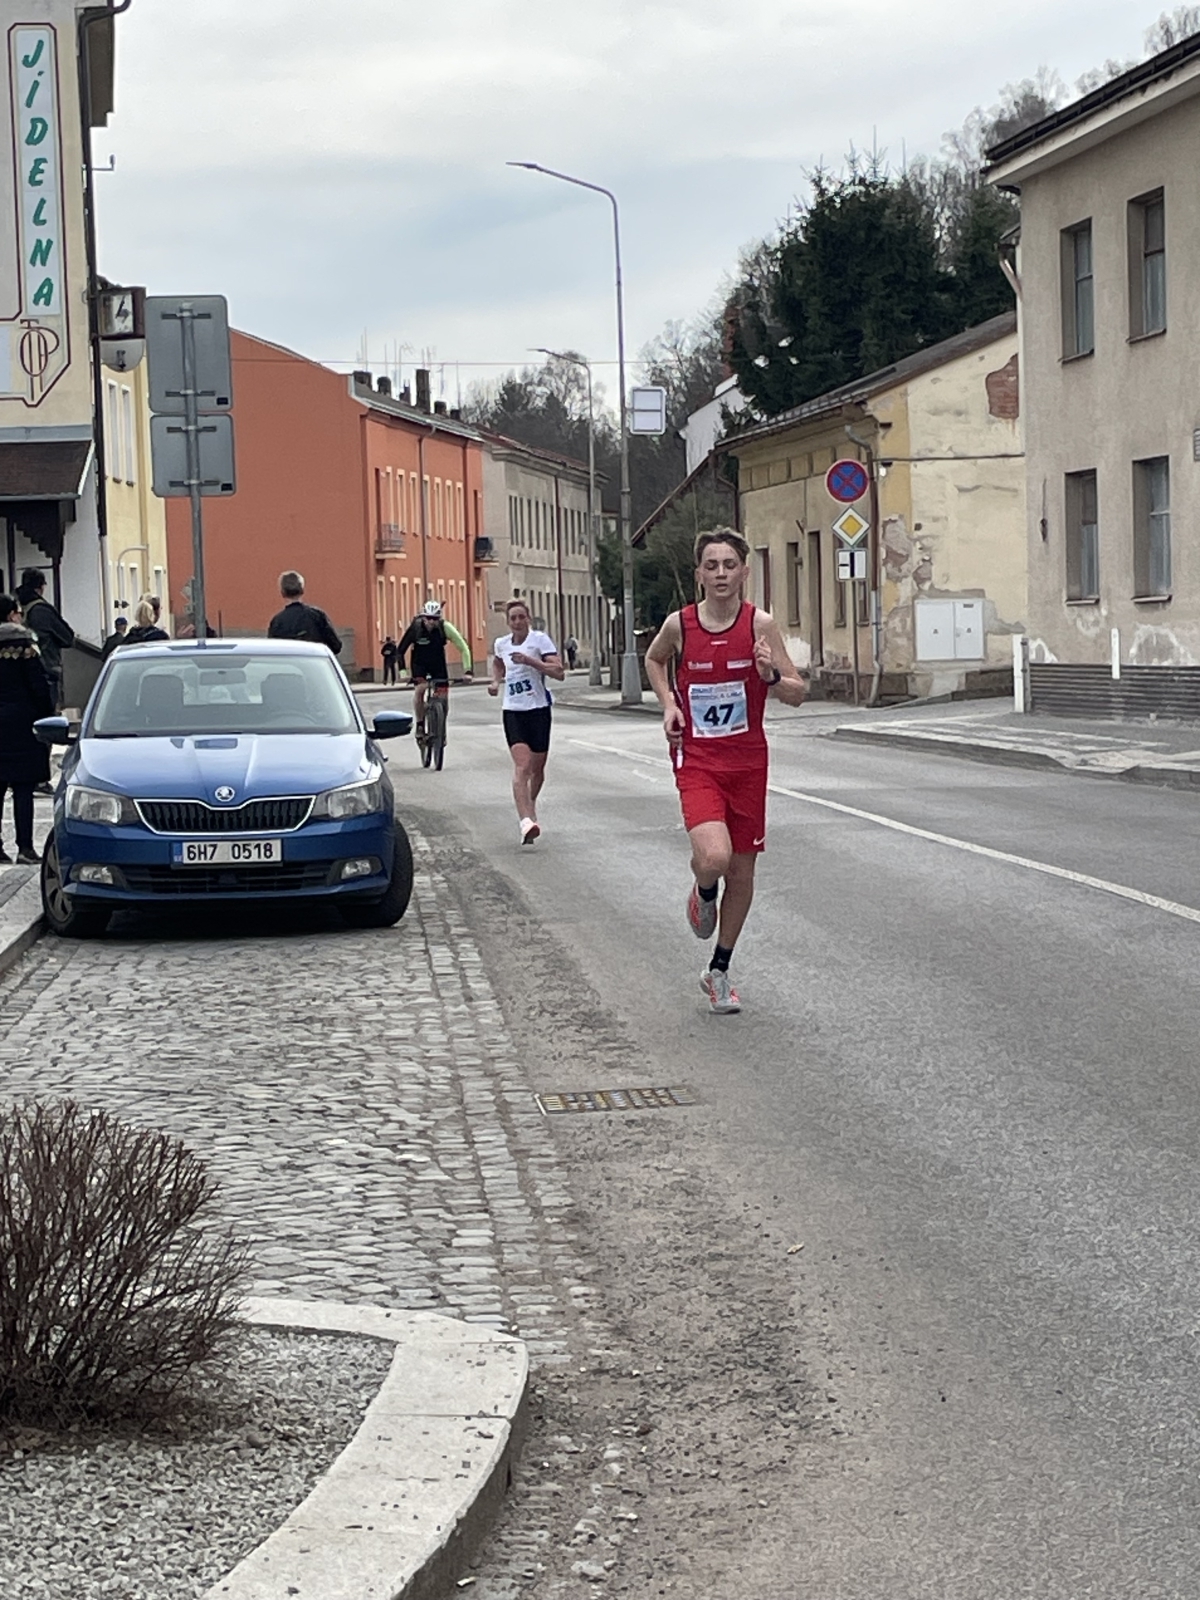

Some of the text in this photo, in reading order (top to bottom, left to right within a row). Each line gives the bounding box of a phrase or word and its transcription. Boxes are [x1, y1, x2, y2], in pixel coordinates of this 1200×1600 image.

[22, 39, 54, 306] JÍDELNA
[703, 703, 735, 726] 47
[187, 842, 273, 861] 6H7 0518
